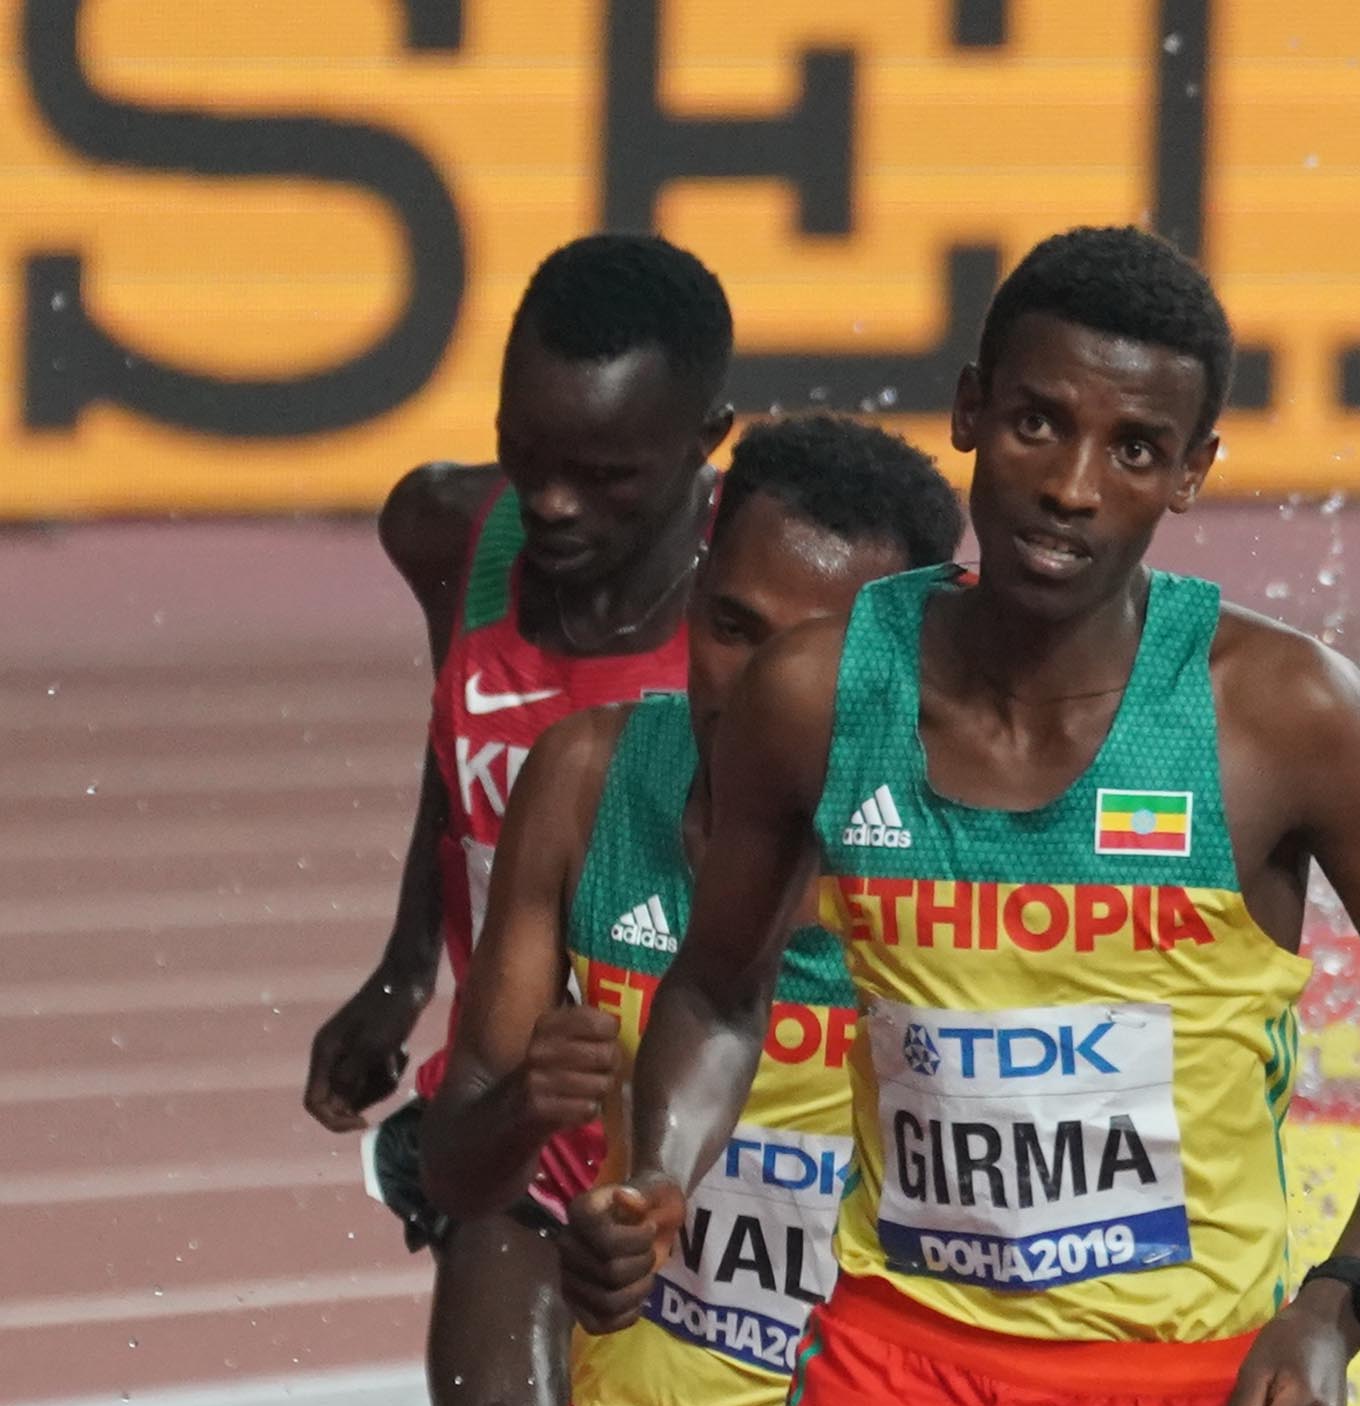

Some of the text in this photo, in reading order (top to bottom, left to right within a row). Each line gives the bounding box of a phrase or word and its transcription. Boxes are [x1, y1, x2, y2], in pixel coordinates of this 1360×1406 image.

[843, 826, 911, 848] adidas
[611, 924, 677, 953] adidas
[838, 877, 1215, 952] ETHIOPIA
[939, 1022, 1121, 1080] TDK
[893, 1109, 1158, 1208] GIRMA
[919, 1228, 1136, 1283] DOHA2019
